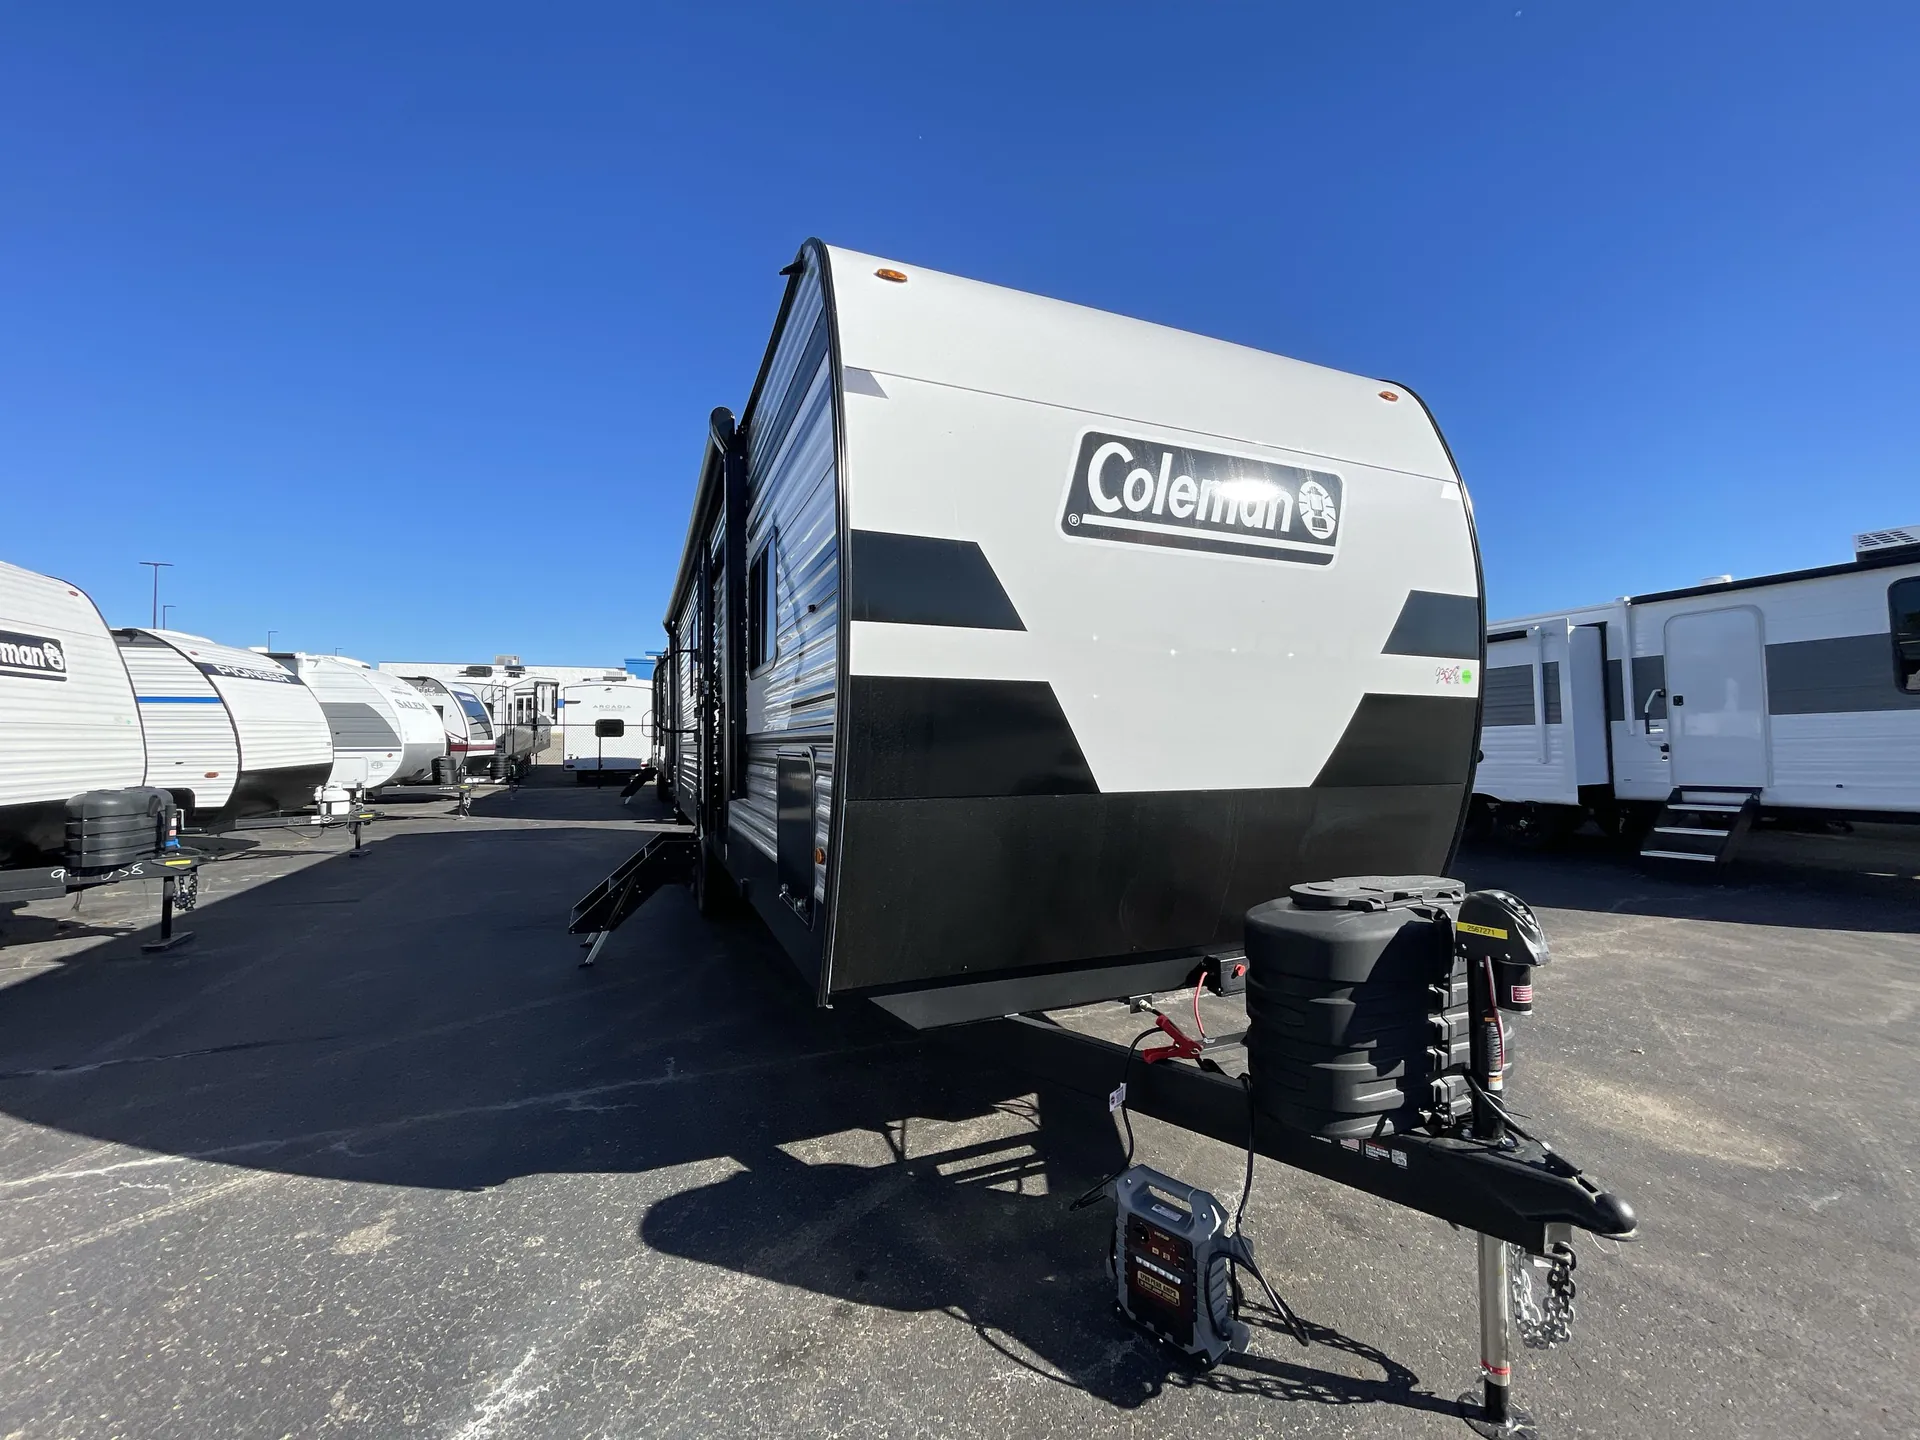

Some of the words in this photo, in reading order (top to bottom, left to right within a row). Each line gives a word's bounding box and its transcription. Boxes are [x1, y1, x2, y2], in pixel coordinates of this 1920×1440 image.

[1088, 441, 1294, 532] Coleman
[0, 642, 46, 668] man
[212, 664, 291, 683] PIONEER
[394, 698, 429, 711] SALEM
[1467, 925, 1495, 935] 2567271
